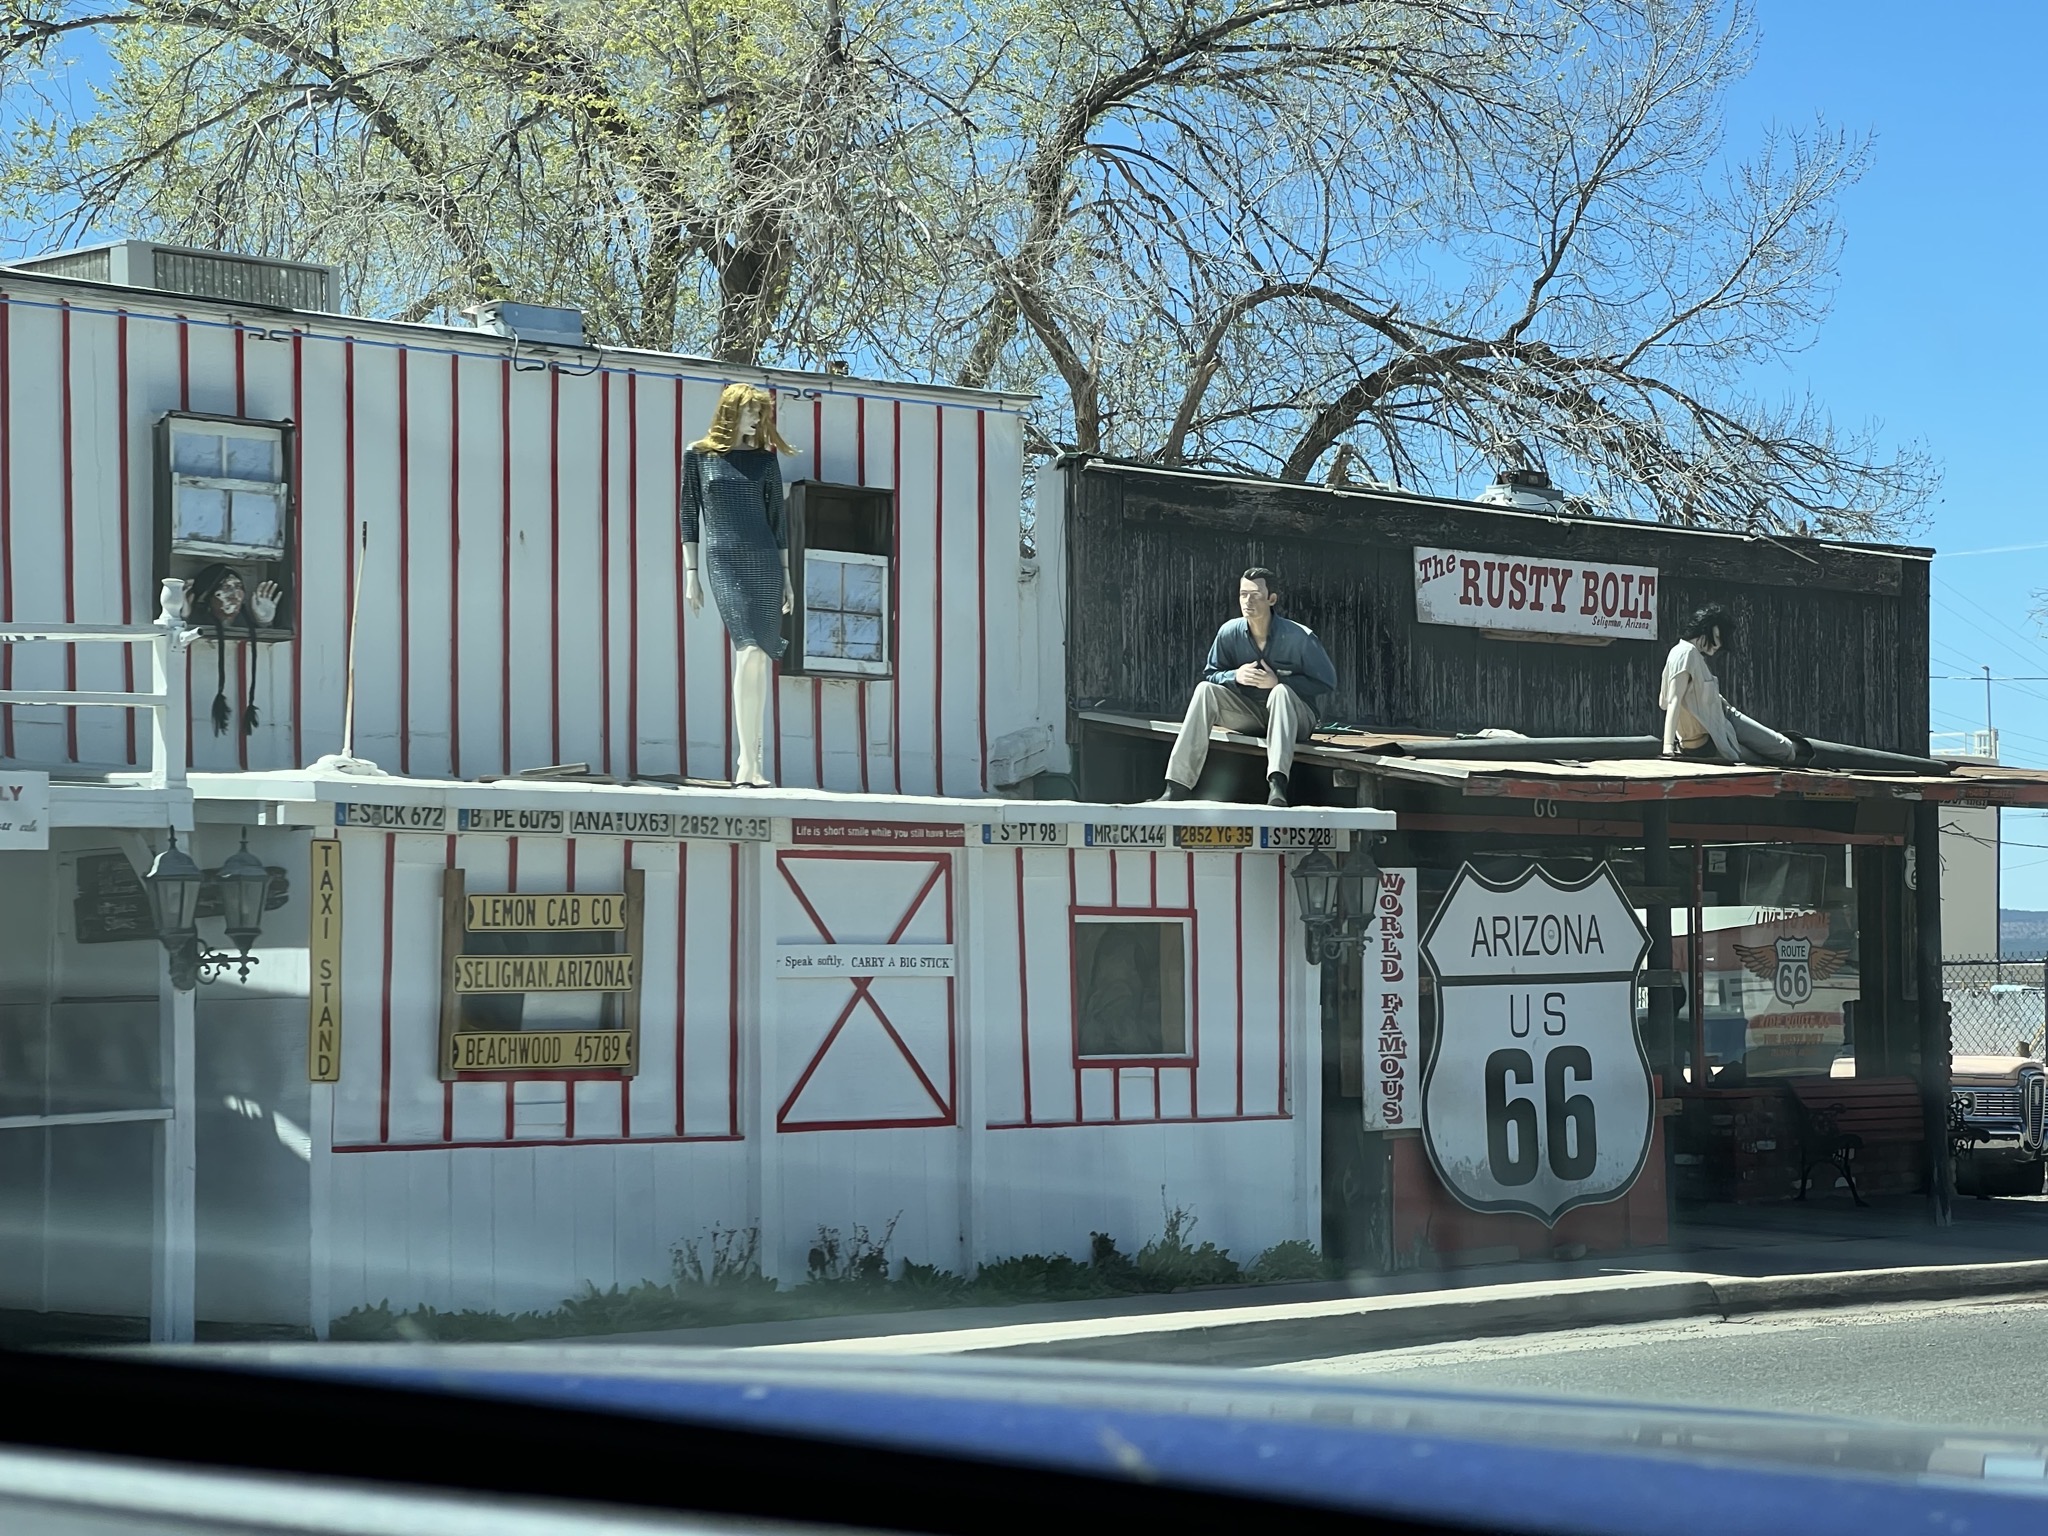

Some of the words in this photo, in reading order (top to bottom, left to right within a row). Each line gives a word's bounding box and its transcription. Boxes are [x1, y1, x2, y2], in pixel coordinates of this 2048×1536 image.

[1419, 553, 1456, 583] The
[1459, 559, 1573, 613] RUSTY
[1580, 570, 1656, 620] BOLT
[1625, 617, 1650, 630] Arizona
[411, 807, 444, 827] 672
[796, 826, 811, 836] Life
[813, 826, 821, 836] is
[824, 826, 845, 836] short
[848, 826, 869, 837] smile
[871, 827, 892, 837] while
[894, 829, 909, 840] you
[910, 828, 924, 838] still
[925, 828, 944, 838] have
[1041, 823, 1056, 842] 98
[1181, 826, 1212, 843] 2852
[1236, 827, 1252, 843] 35
[1289, 827, 1306, 846] PS
[319, 845, 334, 940] TAXI
[481, 898, 536, 927] LEMON
[547, 898, 580, 927] CAB
[591, 898, 612, 926] CO
[1379, 873, 1406, 983] WORLD
[1471, 914, 1605, 958] ARIZONA
[785, 955, 813, 969] Speak
[851, 956, 886, 968] CARRY
[888, 957, 896, 967] A
[900, 957, 917, 968] BIG
[1781, 945, 1806, 958] ROUTE
[555, 959, 626, 988] ARIZONA
[1779, 963, 1808, 998] 66
[318, 959, 334, 1077] STAND
[1785, 1014, 1815, 1030] ROUTE
[465, 1036, 562, 1066] BEACHWOOD
[574, 1035, 621, 1064] 45789
[1378, 993, 1407, 1125] FAMOUS
[1484, 1045, 1598, 1187] 66
